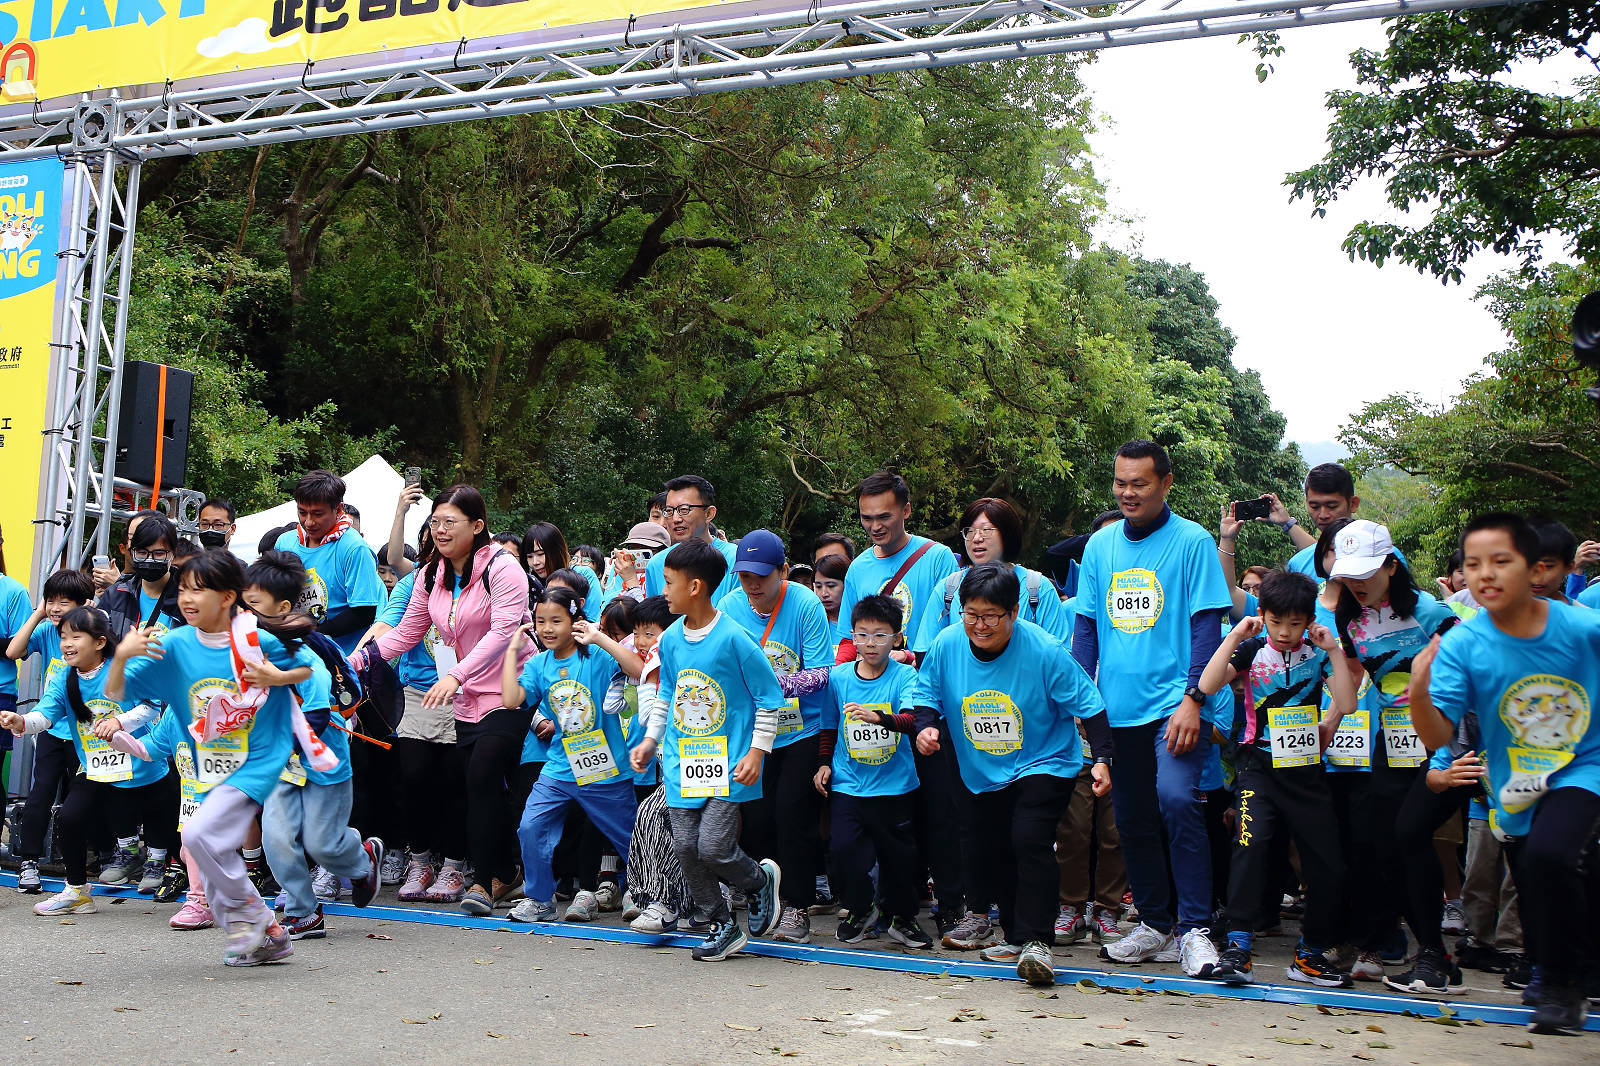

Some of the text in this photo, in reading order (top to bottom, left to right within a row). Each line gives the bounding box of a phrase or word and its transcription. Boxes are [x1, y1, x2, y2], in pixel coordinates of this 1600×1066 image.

[1117, 596, 1150, 610] 0818
[1274, 713, 1307, 721] MIAOLI
[853, 728, 889, 741] 0819
[974, 722, 1010, 734] 0817
[1277, 732, 1315, 749] 1246
[1387, 735, 1418, 749] 1247
[92, 752, 126, 769] 0427
[575, 752, 608, 769] 1039
[686, 764, 723, 779] 0039
